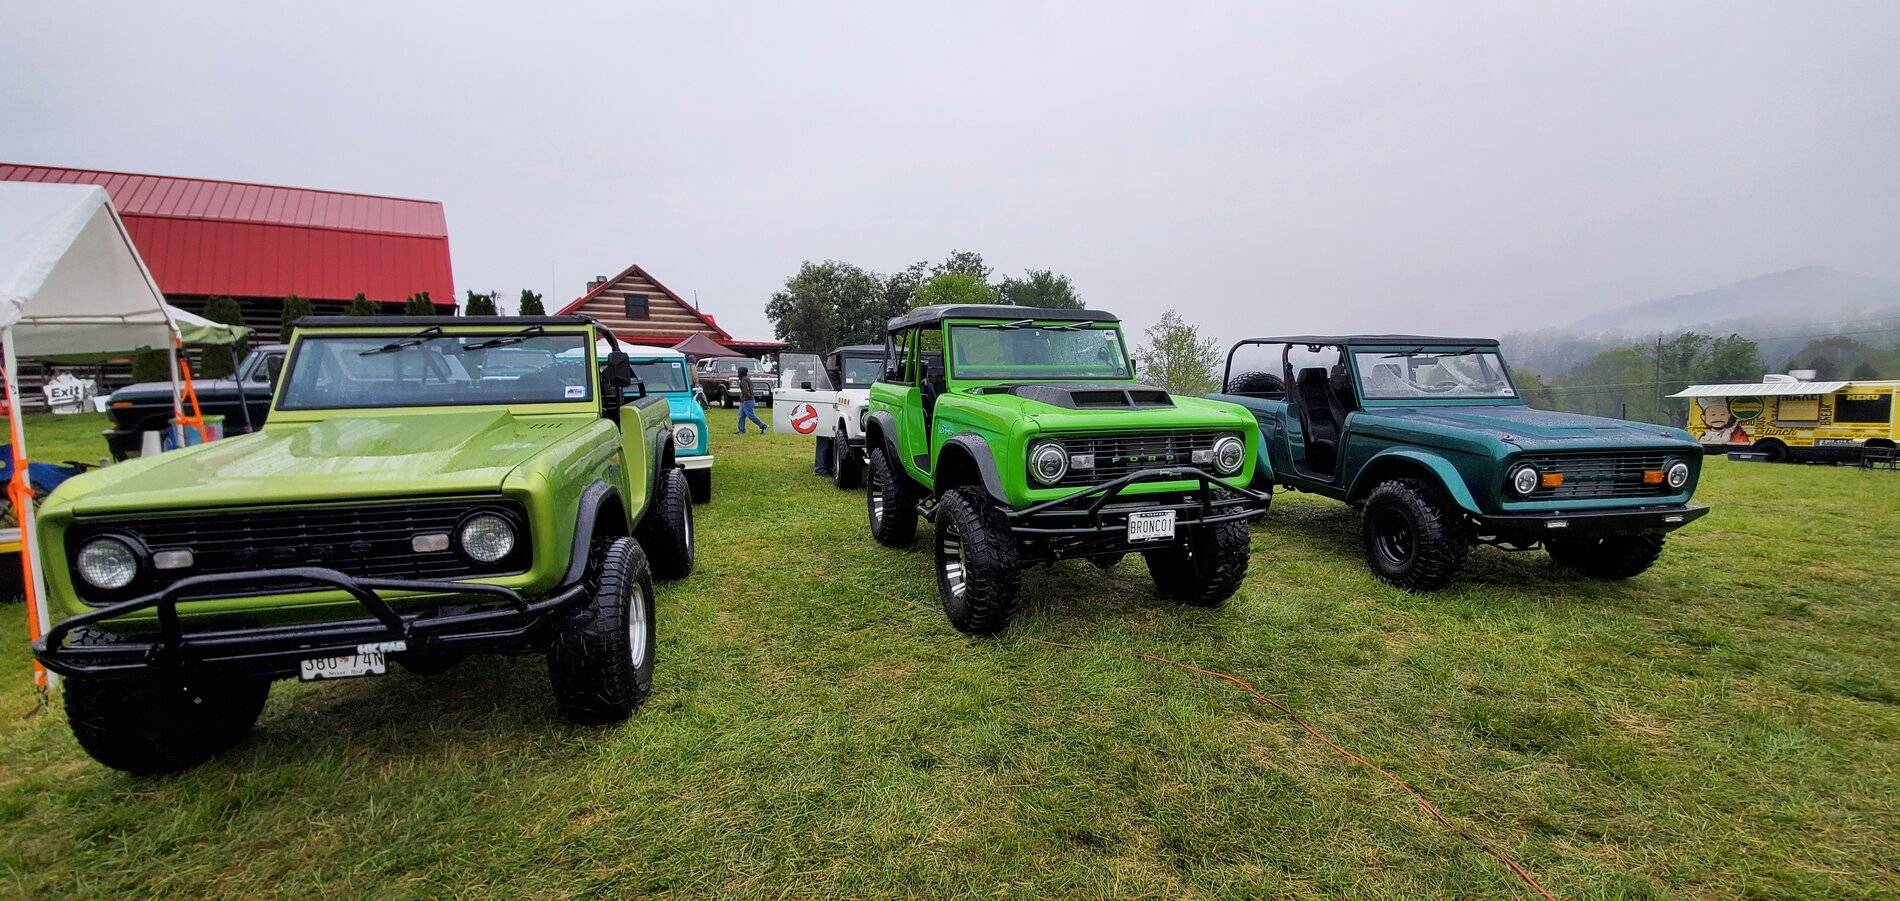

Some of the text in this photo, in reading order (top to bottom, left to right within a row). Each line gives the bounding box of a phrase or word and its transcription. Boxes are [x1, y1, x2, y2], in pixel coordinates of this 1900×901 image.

[51, 386, 80, 397] Exit
[1112, 454, 1174, 463] FORD
[1130, 518, 1172, 534] BRONCO1
